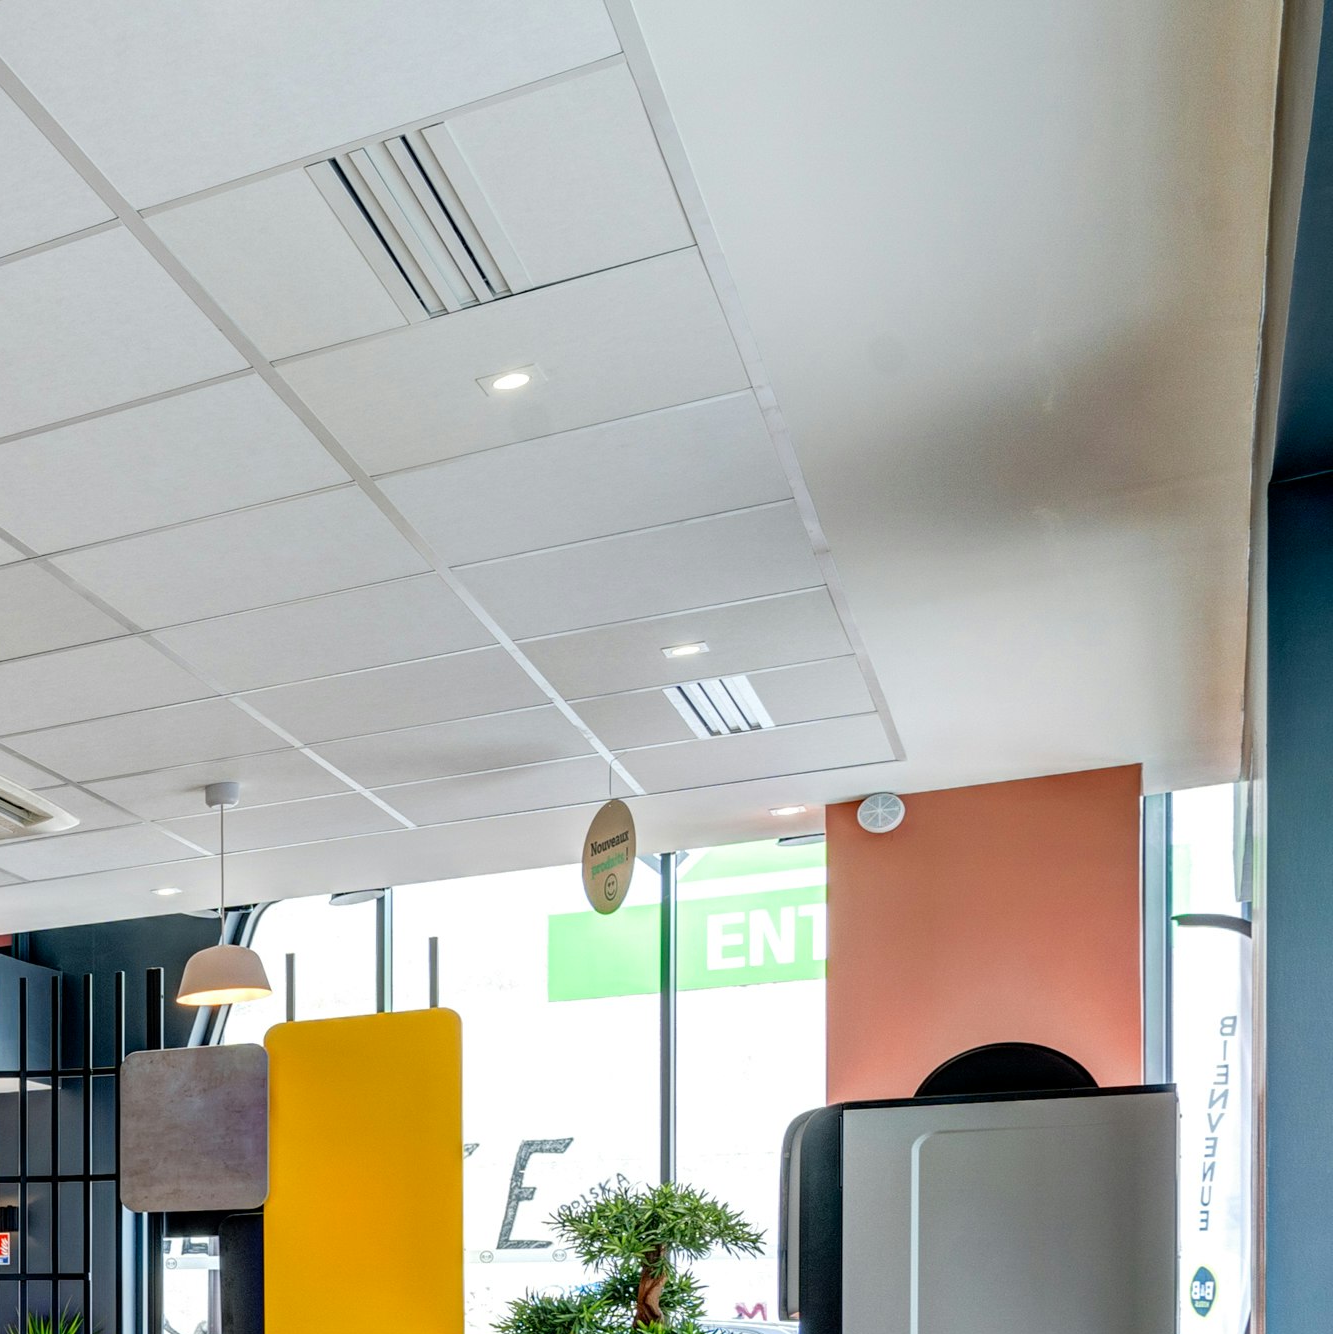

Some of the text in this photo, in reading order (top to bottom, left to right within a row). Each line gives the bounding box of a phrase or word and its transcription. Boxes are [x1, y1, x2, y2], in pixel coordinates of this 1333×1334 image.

[590, 830, 629, 857] Nouveaux
[706, 902, 827, 971] ENT
[463, 1137, 574, 1249] E
